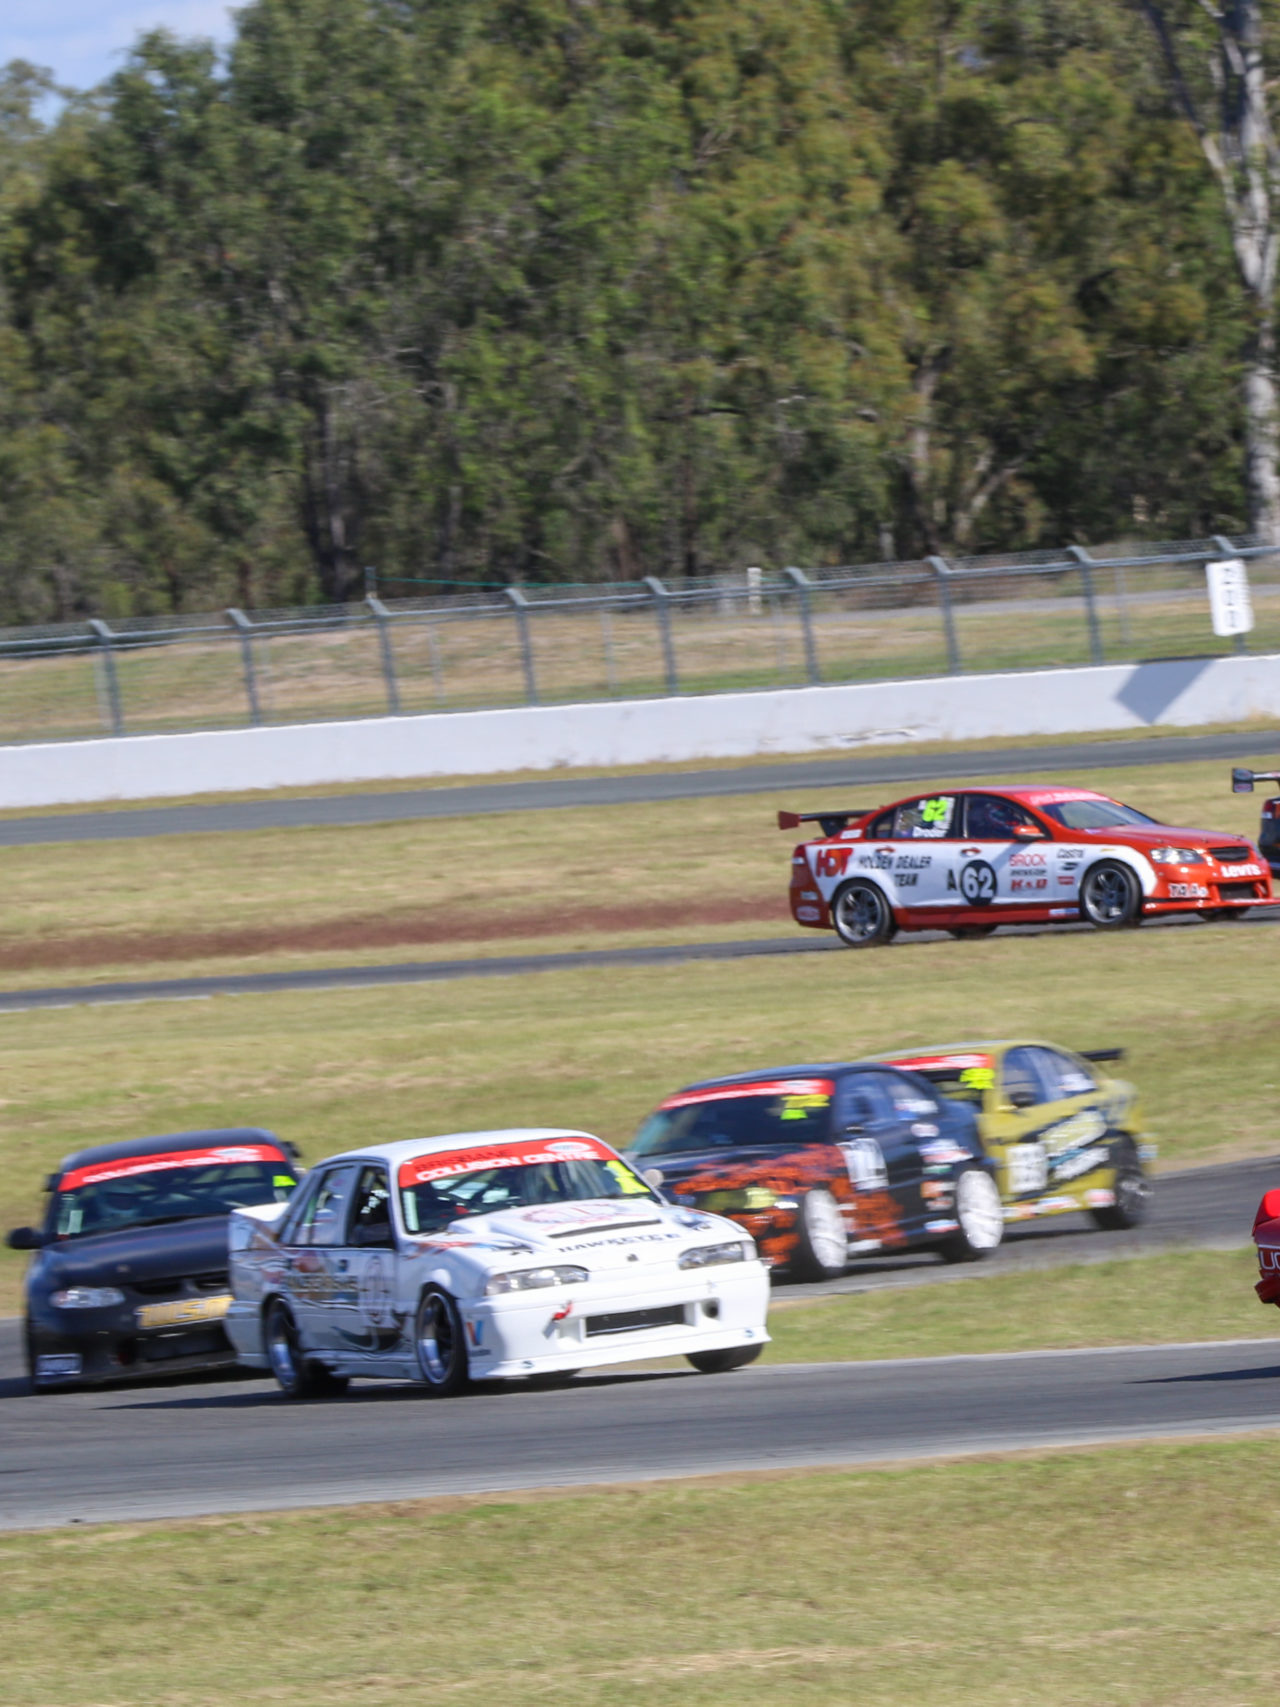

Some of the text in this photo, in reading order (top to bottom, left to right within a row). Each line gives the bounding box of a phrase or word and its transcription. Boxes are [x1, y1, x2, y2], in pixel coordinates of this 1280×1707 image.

[922, 799, 948, 822] 62
[895, 855, 932, 870] DEALER
[895, 872, 919, 887] TEAM
[946, 869, 957, 891] A
[963, 865, 993, 899] 62
[416, 1156, 522, 1182] COLLISION
